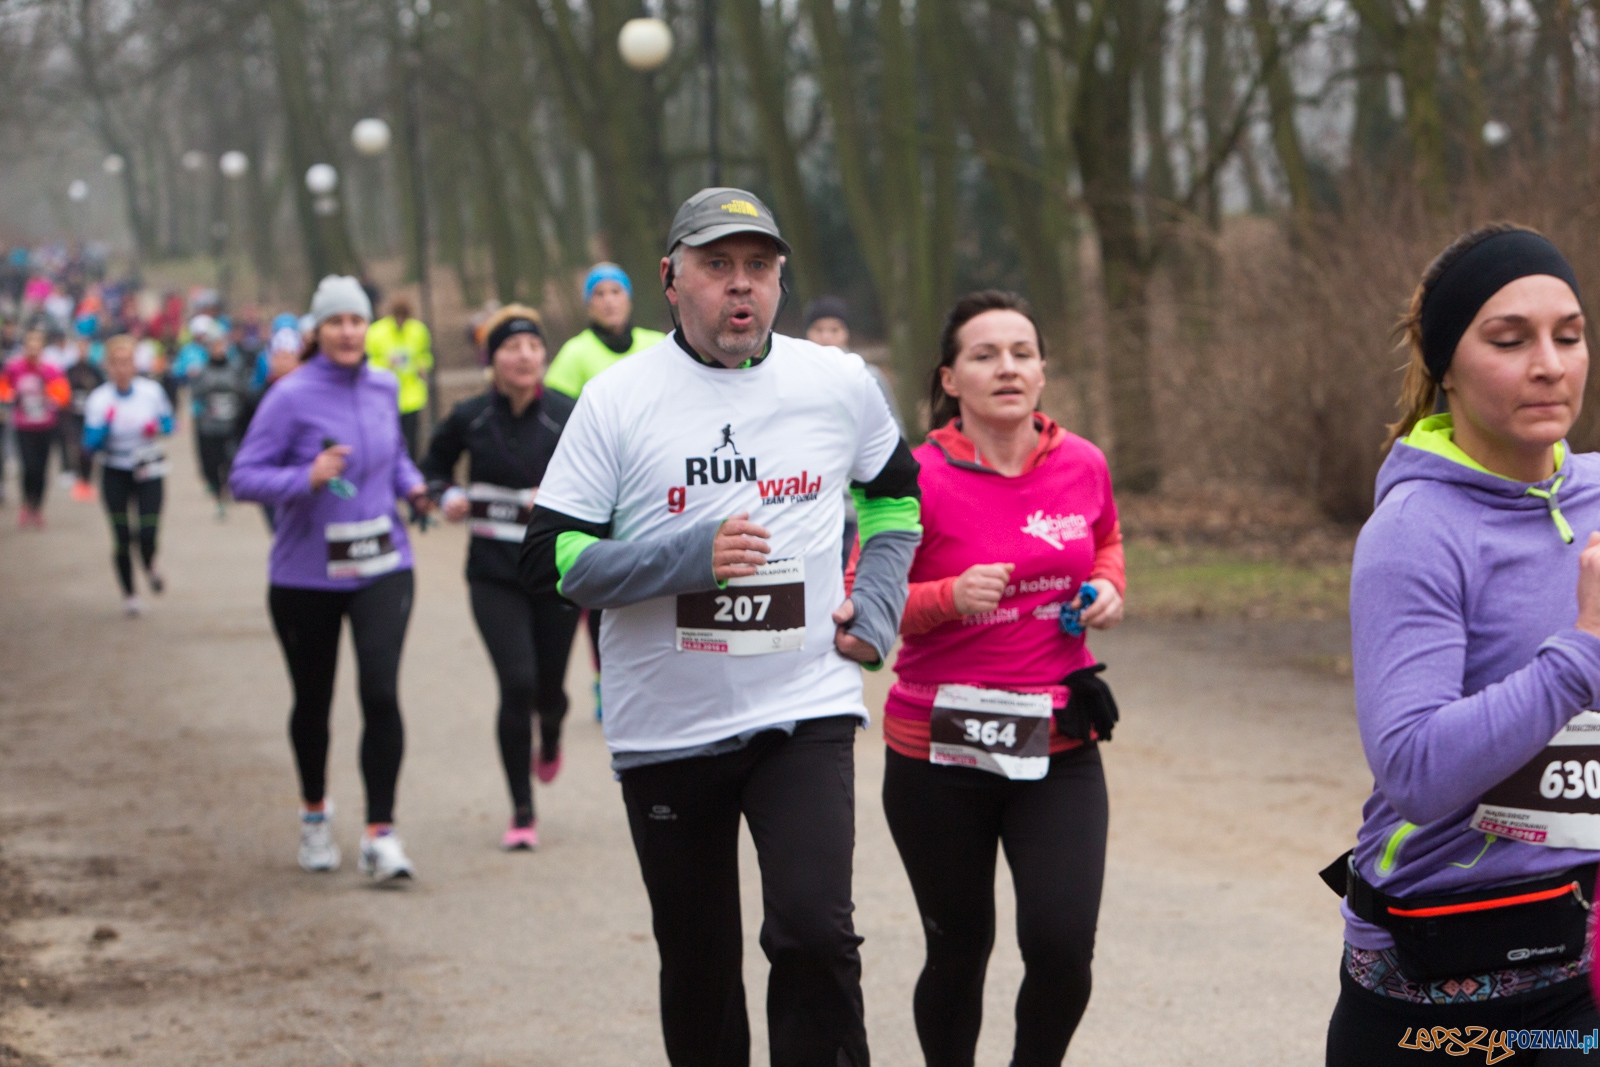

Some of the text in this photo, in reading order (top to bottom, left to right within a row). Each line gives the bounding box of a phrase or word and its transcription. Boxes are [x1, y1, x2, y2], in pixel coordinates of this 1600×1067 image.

[667, 456, 822, 514] g RUN wald
[761, 496, 785, 506] TEAM
[714, 595, 771, 622] 207
[963, 718, 1017, 748] 364
[1539, 760, 1600, 799] 630
